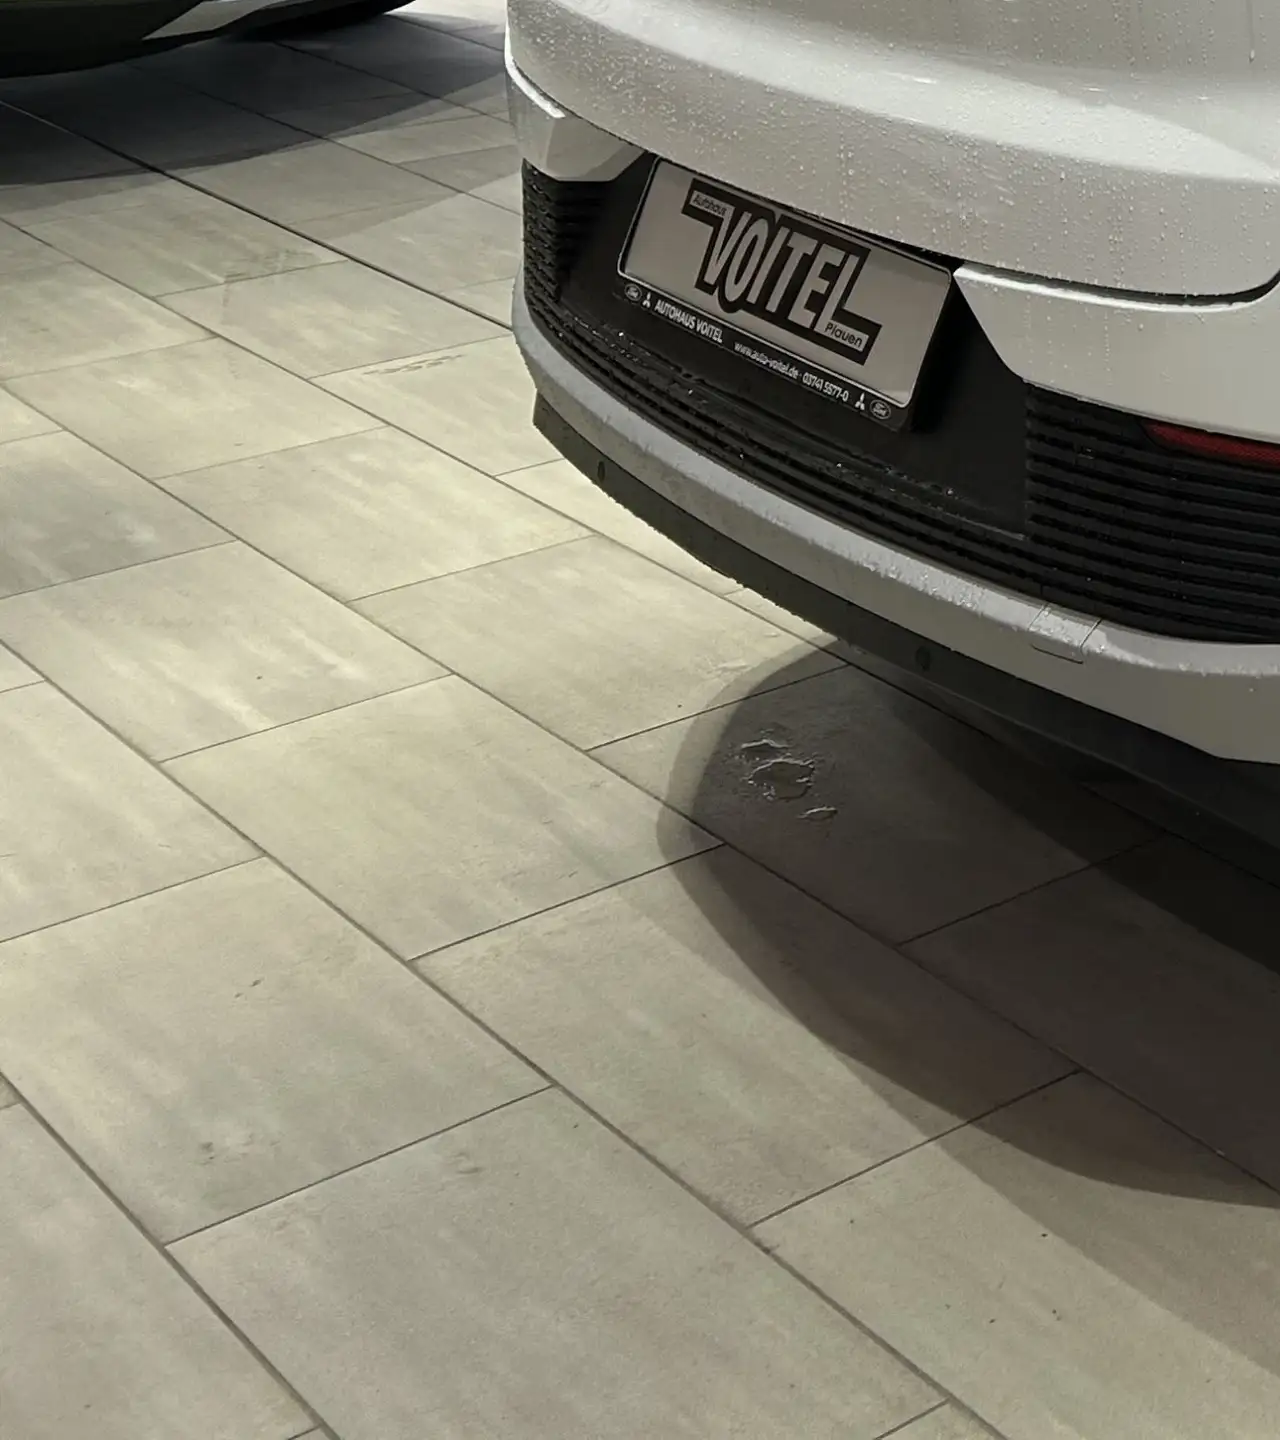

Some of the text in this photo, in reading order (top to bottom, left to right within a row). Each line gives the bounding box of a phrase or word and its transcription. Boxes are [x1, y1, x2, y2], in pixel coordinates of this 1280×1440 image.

[702, 208, 866, 340] VOITEL
[654, 299, 723, 343] AUTOHAUS VOITEL
[824, 322, 863, 349] Plauen
